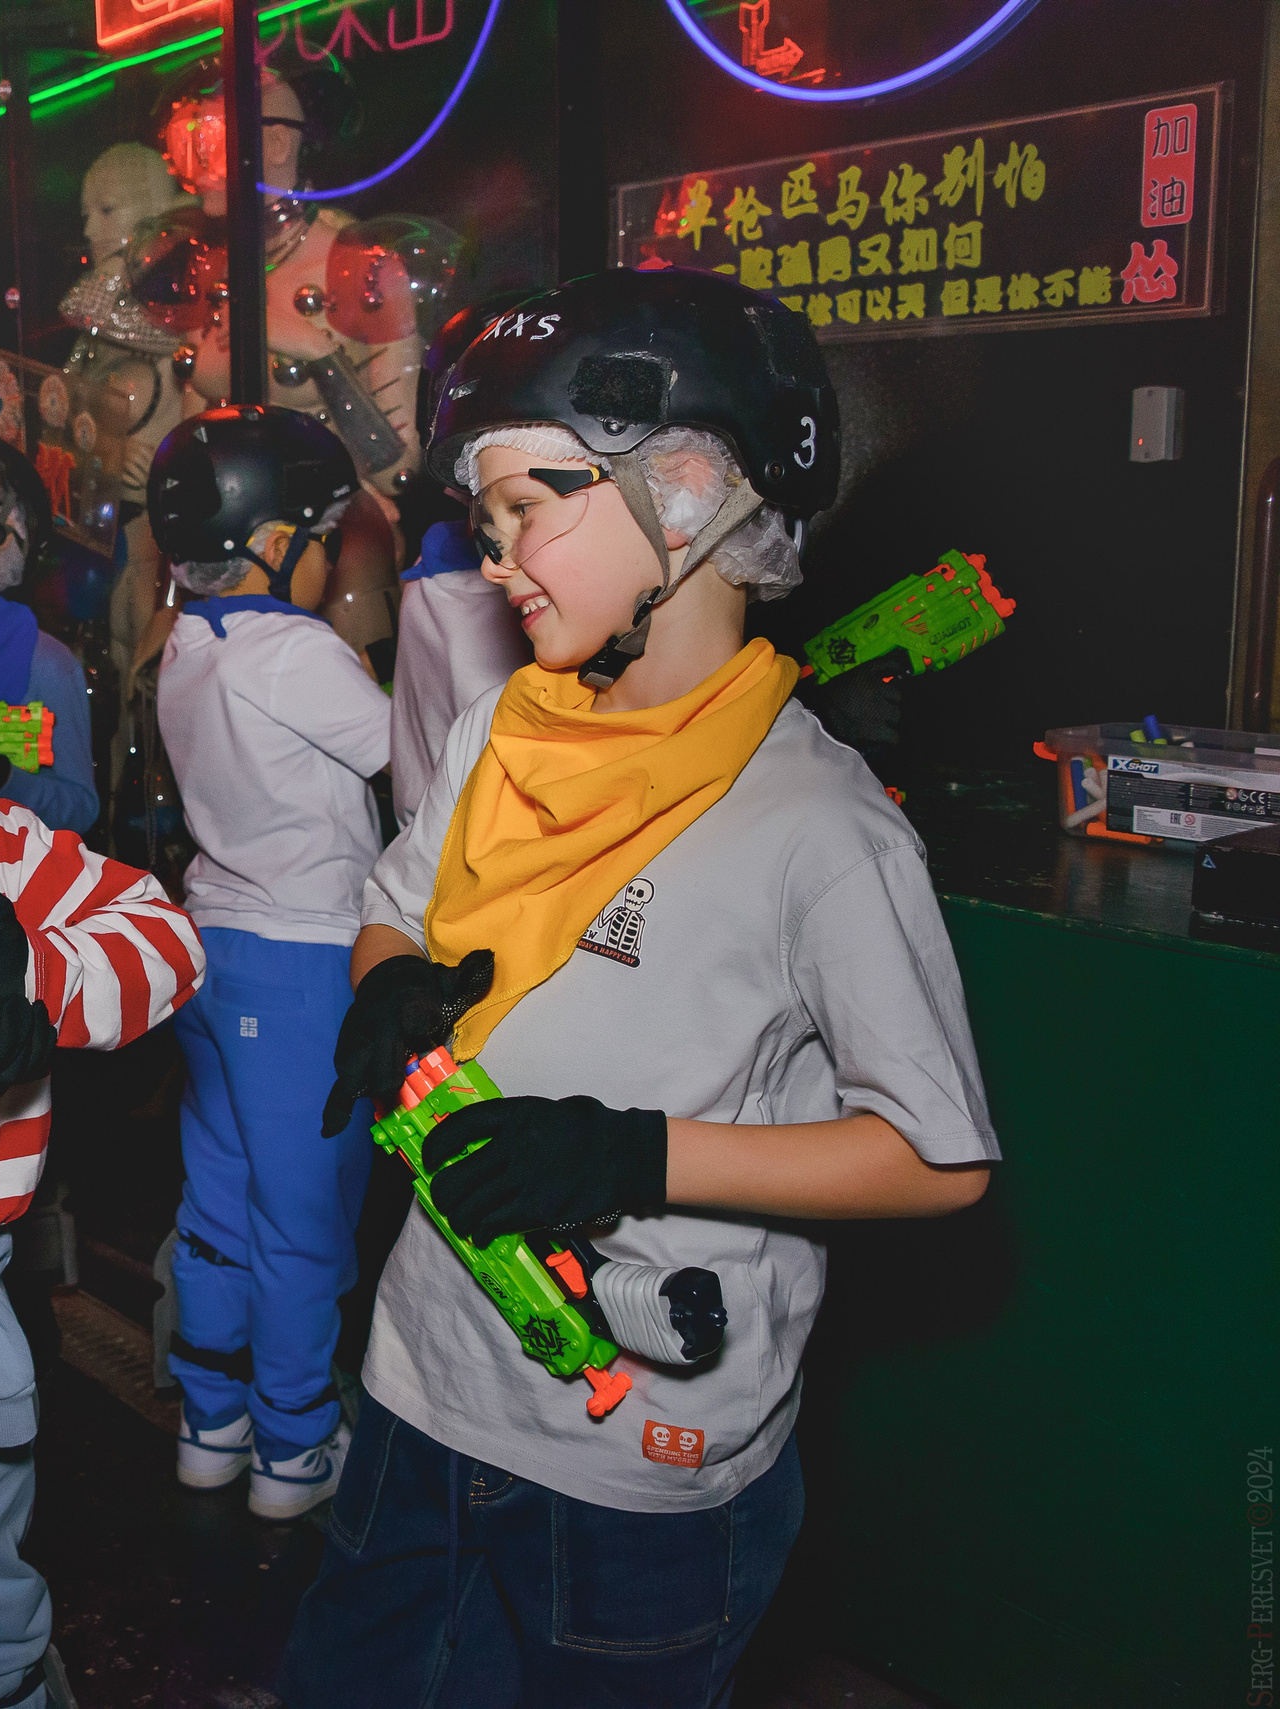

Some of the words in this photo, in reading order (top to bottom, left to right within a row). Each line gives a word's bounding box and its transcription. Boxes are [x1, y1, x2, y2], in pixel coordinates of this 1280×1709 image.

[676, 138, 1046, 250] 单枪匹马你别怕
[1148, 115, 1191, 220] 加油
[1121, 239, 1179, 305] 怂
[483, 312, 562, 341] XXS
[793, 415, 818, 470] 3
[600, 947, 621, 959] HAPPY
[621, 955, 636, 965] DAY
[646, 1445, 681, 1456] SPENDING
